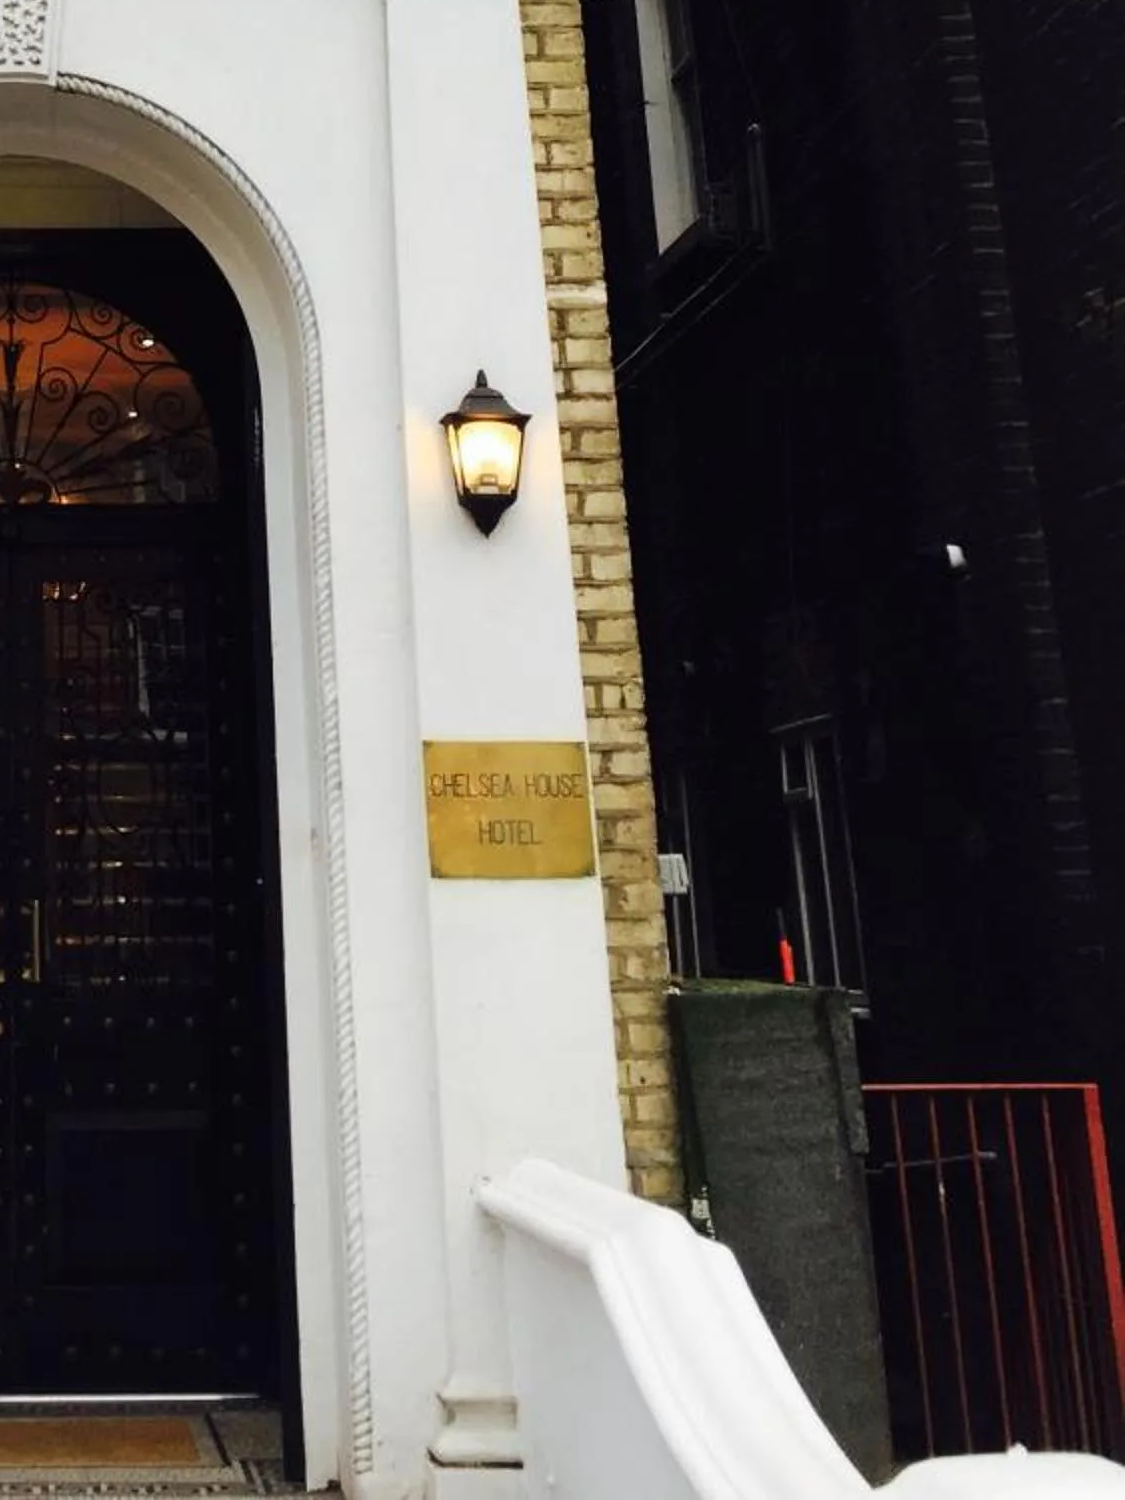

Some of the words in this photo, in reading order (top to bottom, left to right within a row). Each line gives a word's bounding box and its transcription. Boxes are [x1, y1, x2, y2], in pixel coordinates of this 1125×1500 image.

[429, 772, 515, 799] CHELSEA
[525, 772, 584, 799] HOUSE
[477, 819, 543, 846] HOTEL
